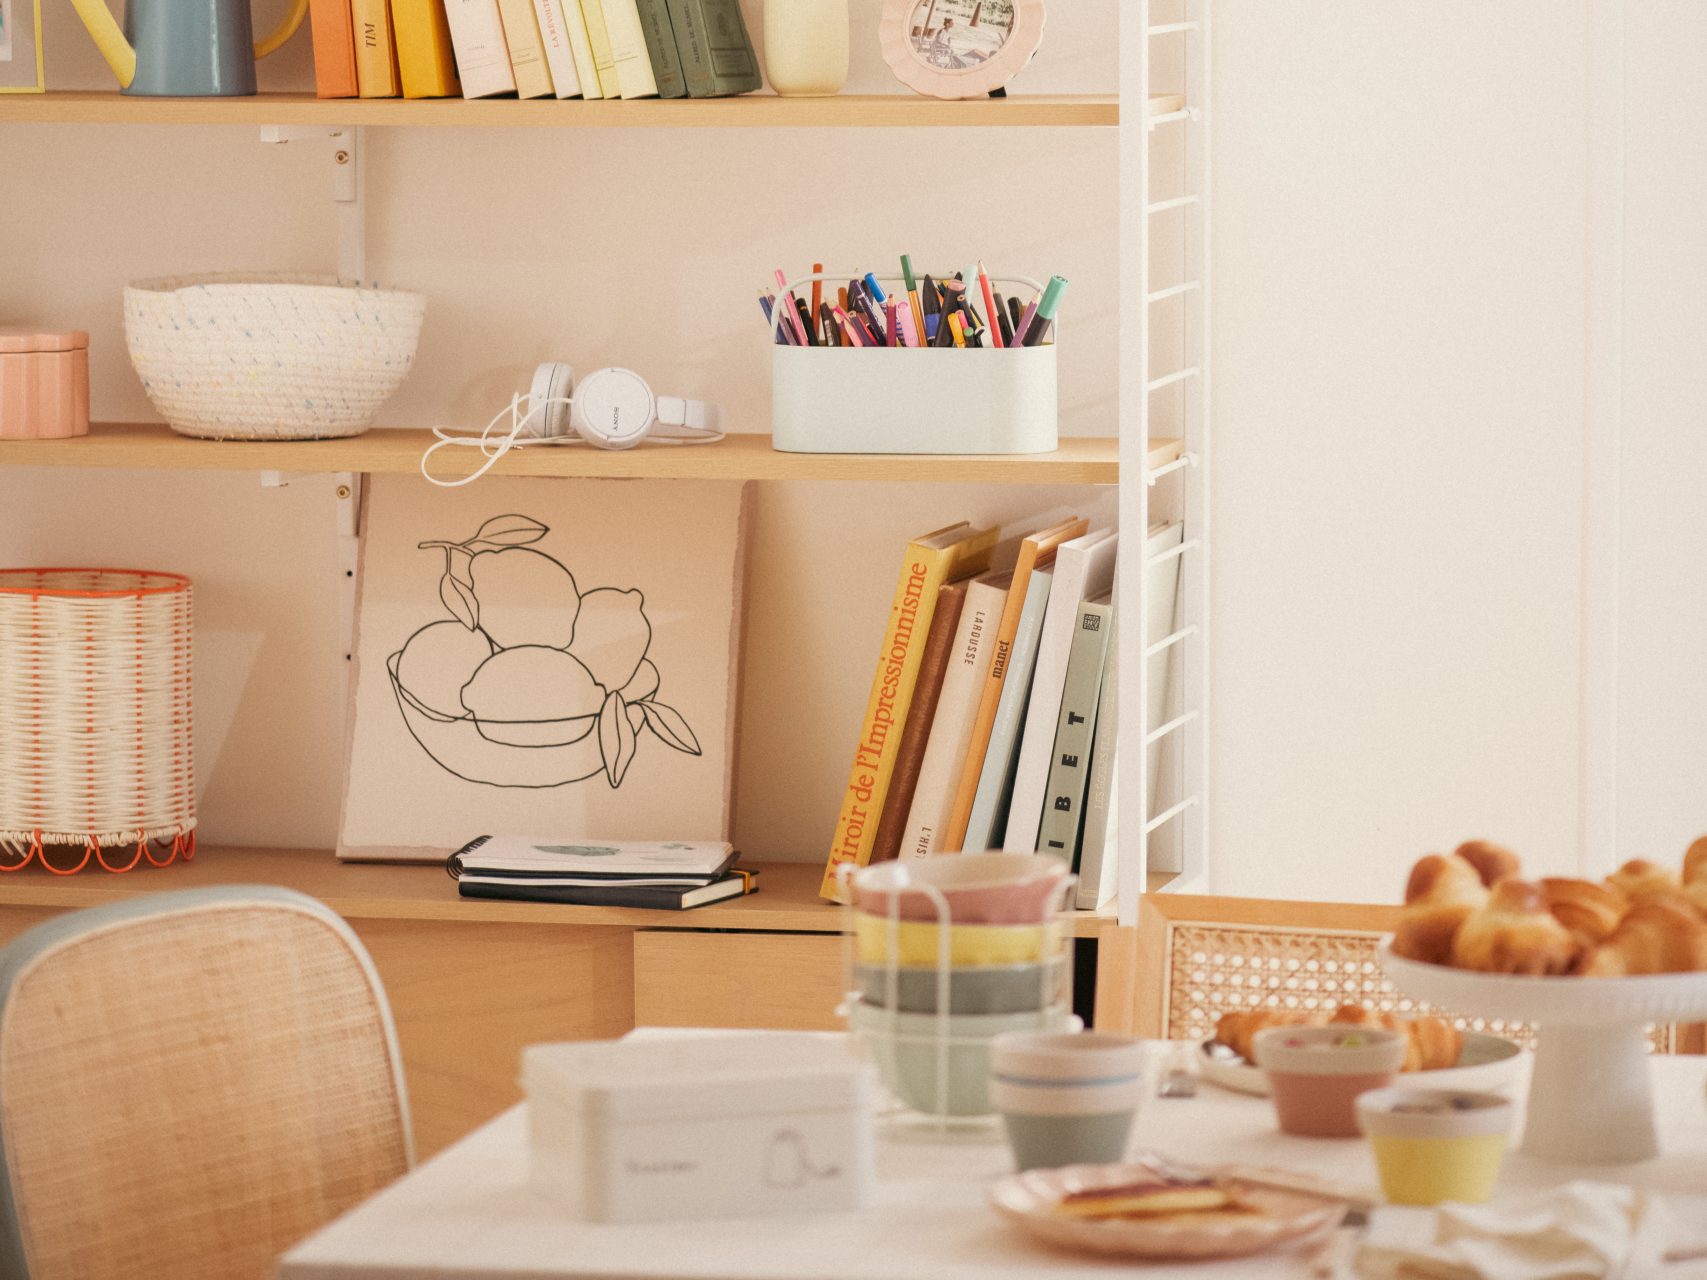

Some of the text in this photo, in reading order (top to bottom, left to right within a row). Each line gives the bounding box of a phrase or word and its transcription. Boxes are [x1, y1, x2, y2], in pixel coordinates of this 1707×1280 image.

[365, 22, 377, 48] TIM
[964, 611, 986, 665] LAROUSSE
[992, 639, 1011, 679] manet
[857, 562, 928, 771] l'Impressionnisme
[849, 774, 875, 804] de
[1048, 711, 1085, 849] IBET
